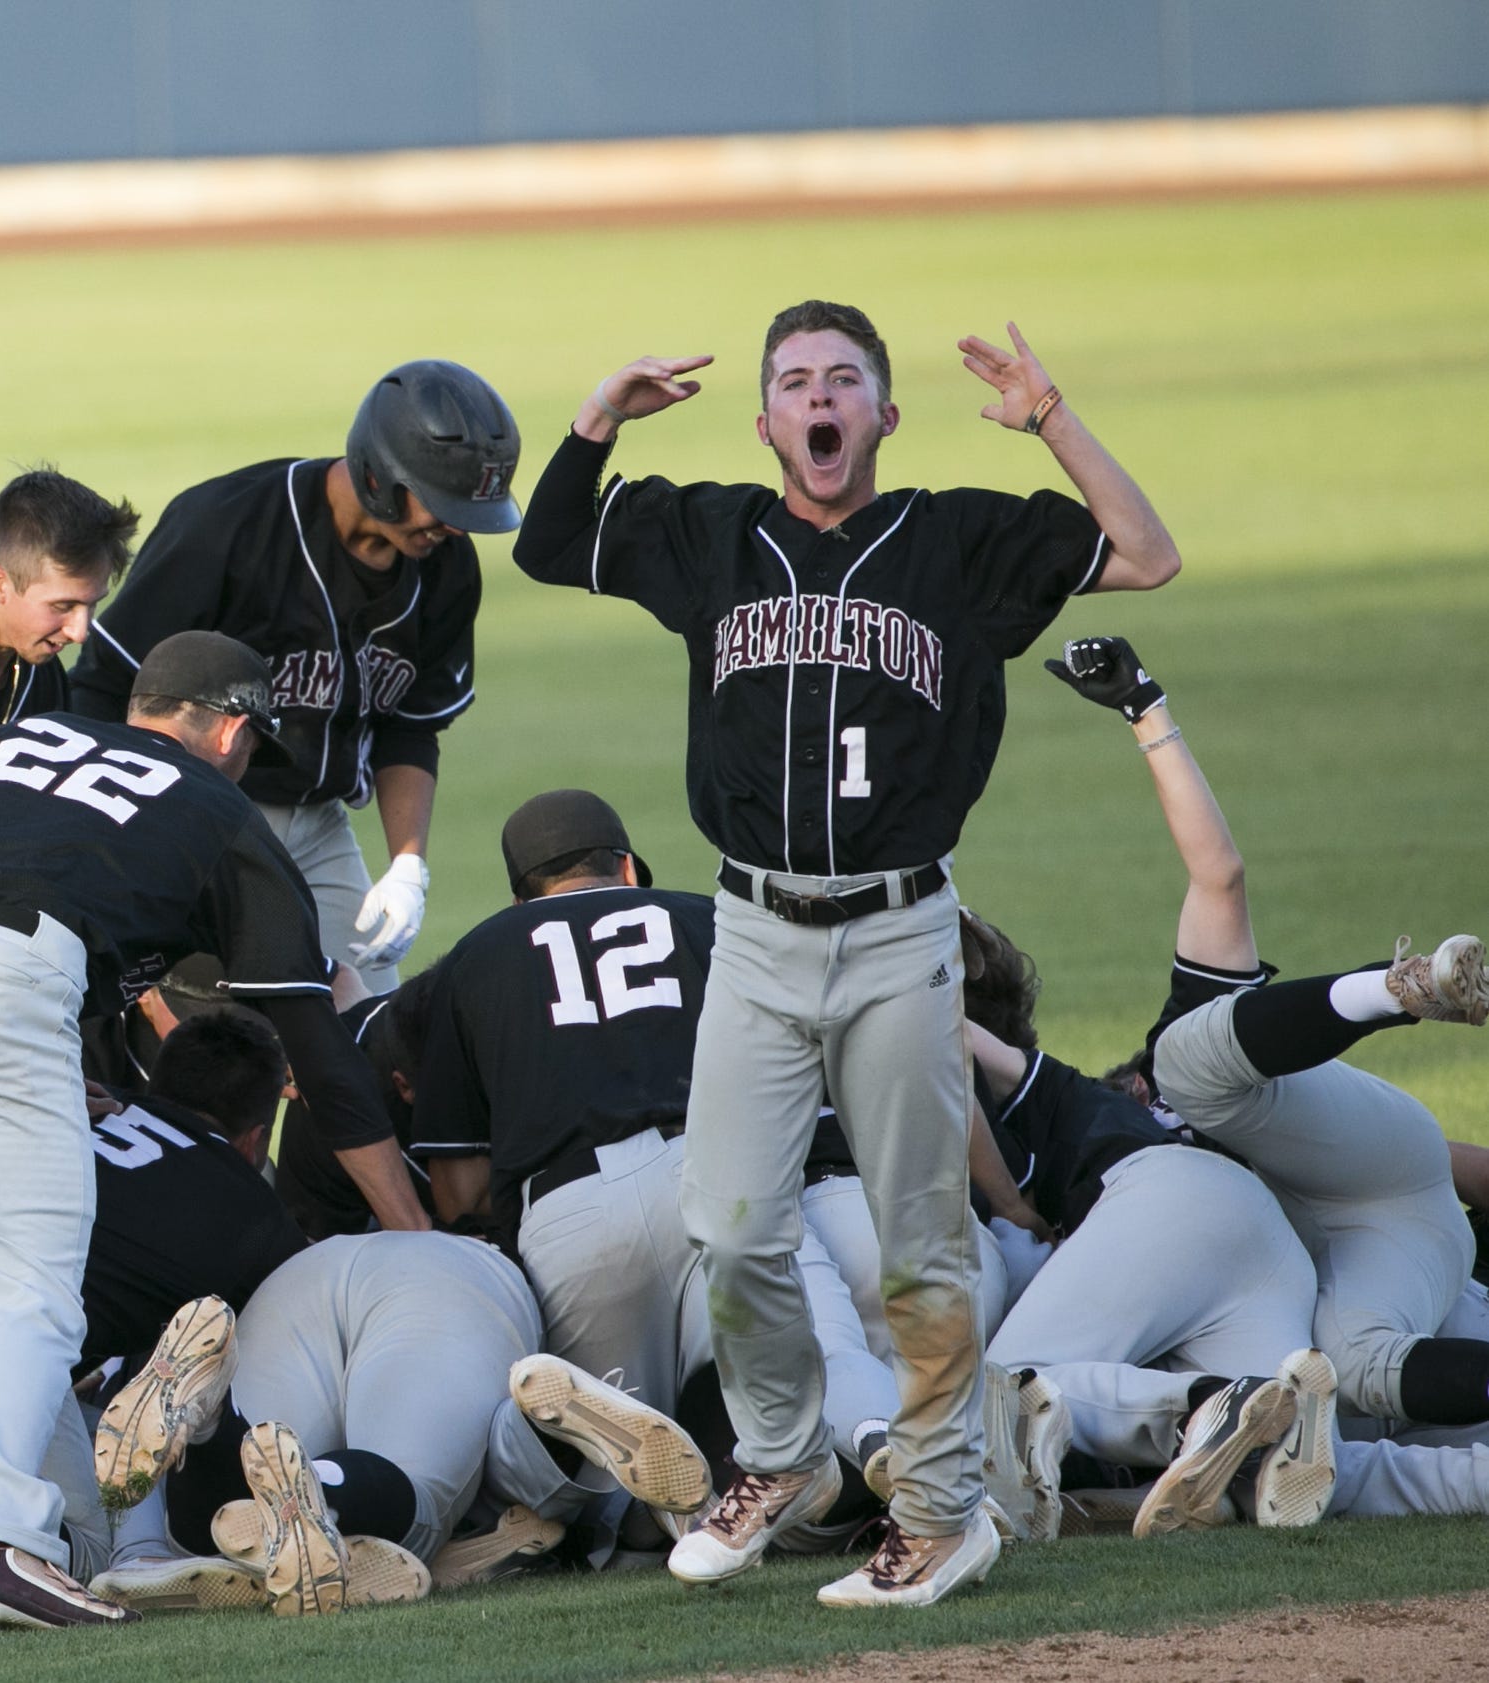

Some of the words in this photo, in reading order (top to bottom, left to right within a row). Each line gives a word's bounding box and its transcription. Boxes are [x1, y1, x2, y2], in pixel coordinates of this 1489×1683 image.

[714, 594, 943, 711] HAMILTON
[839, 726, 872, 798] 1
[529, 904, 683, 1027] 12
